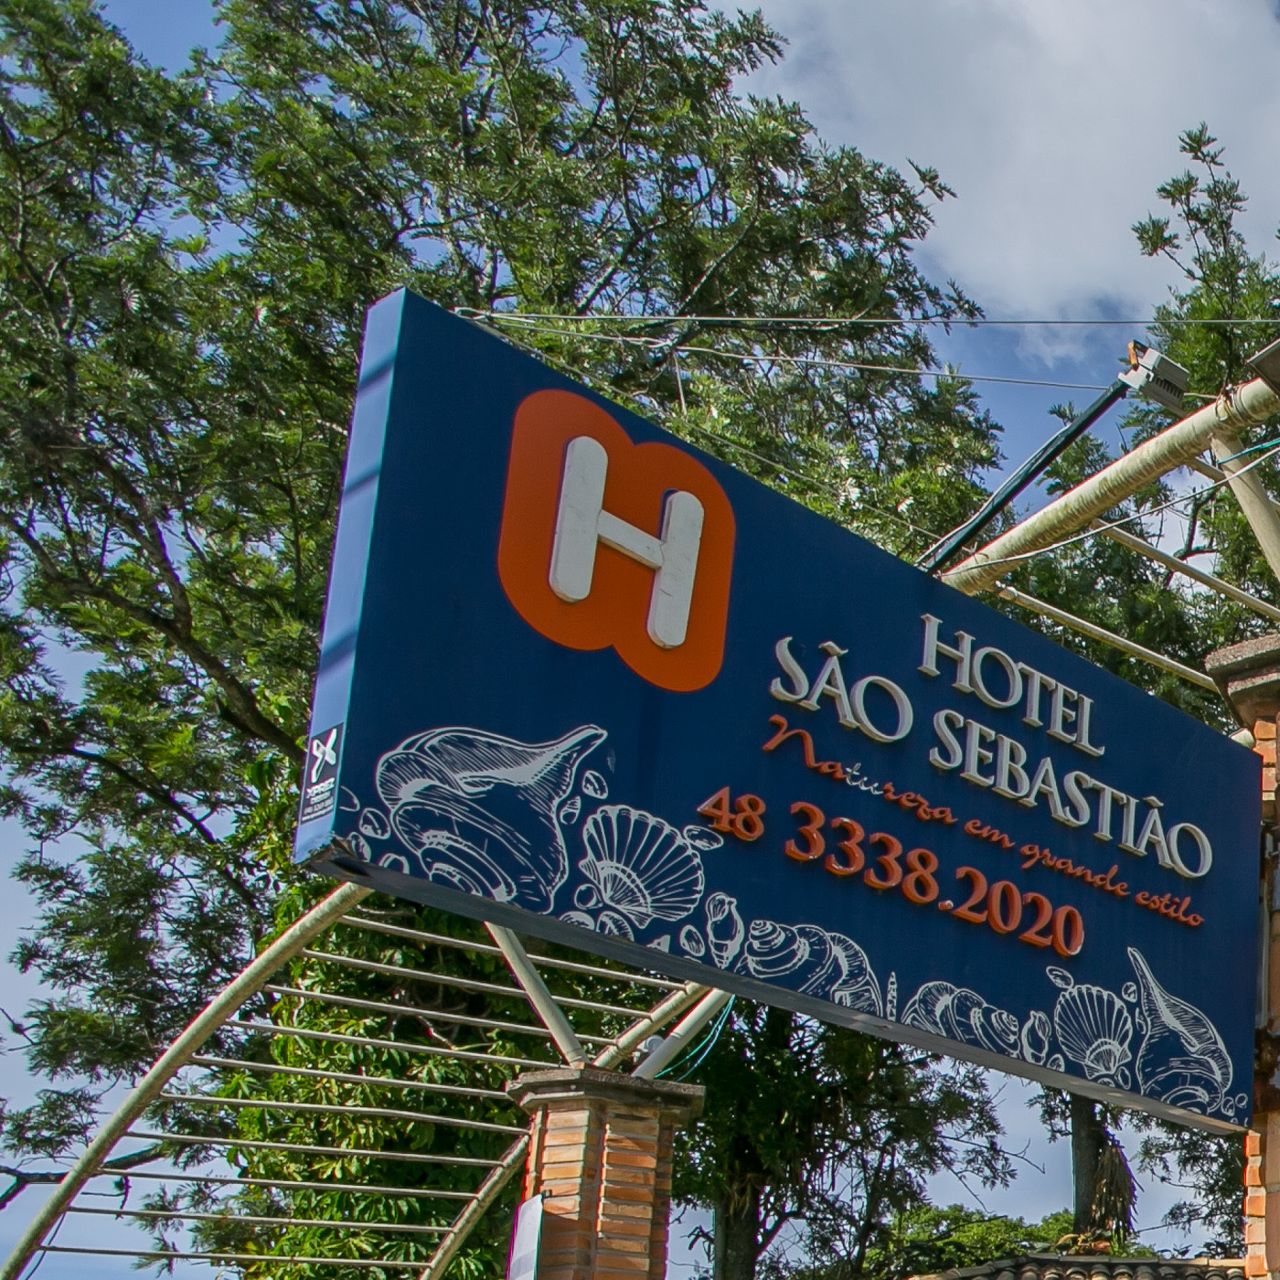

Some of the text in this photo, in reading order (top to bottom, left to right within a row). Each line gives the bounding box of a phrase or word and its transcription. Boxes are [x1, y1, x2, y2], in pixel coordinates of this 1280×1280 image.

[549, 436, 704, 648] H
[770, 636, 1213, 879] SÃO SEBASTIÃO
[918, 613, 1105, 757] HOTEL
[697, 786, 1085, 959] 48 3338.2020
[762, 714, 1206, 928] Natureza em grande estilo
